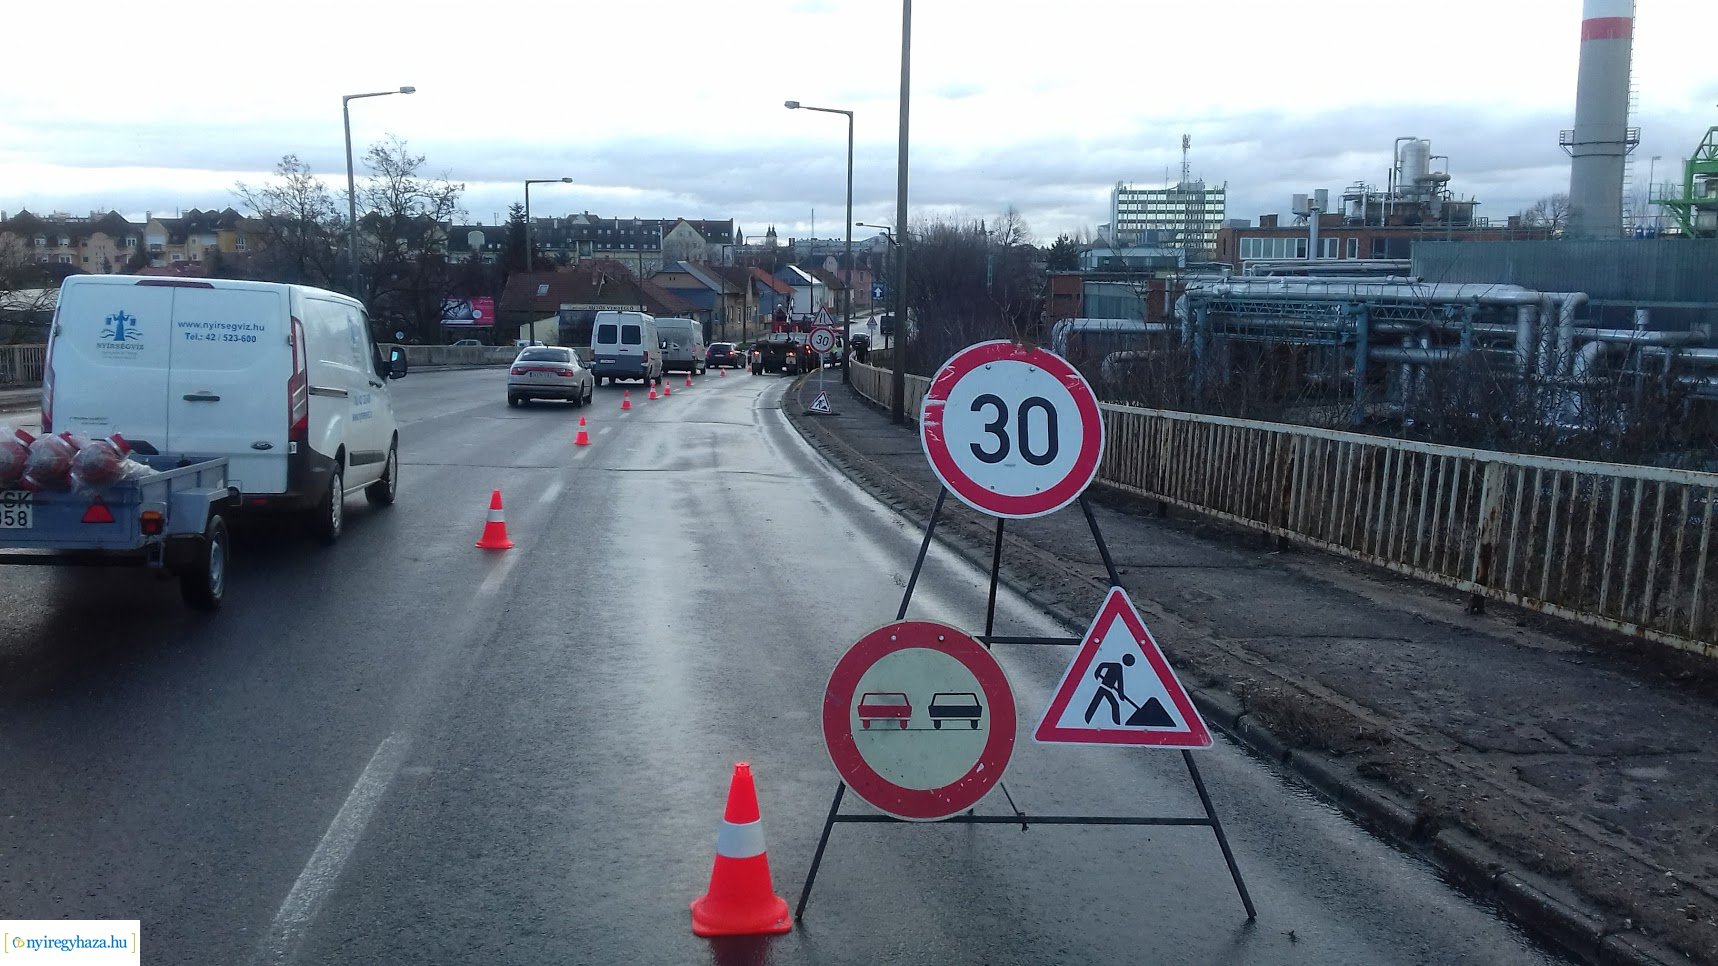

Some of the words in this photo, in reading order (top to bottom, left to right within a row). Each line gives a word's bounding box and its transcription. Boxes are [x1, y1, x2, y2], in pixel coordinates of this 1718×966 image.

[185, 332, 203, 341] Tel.:
[205, 333, 216, 341] 42
[223, 335, 257, 343] 523-600
[815, 334, 829, 347] 30
[969, 393, 1059, 466] 30
[0, 510, 28, 526] 58
